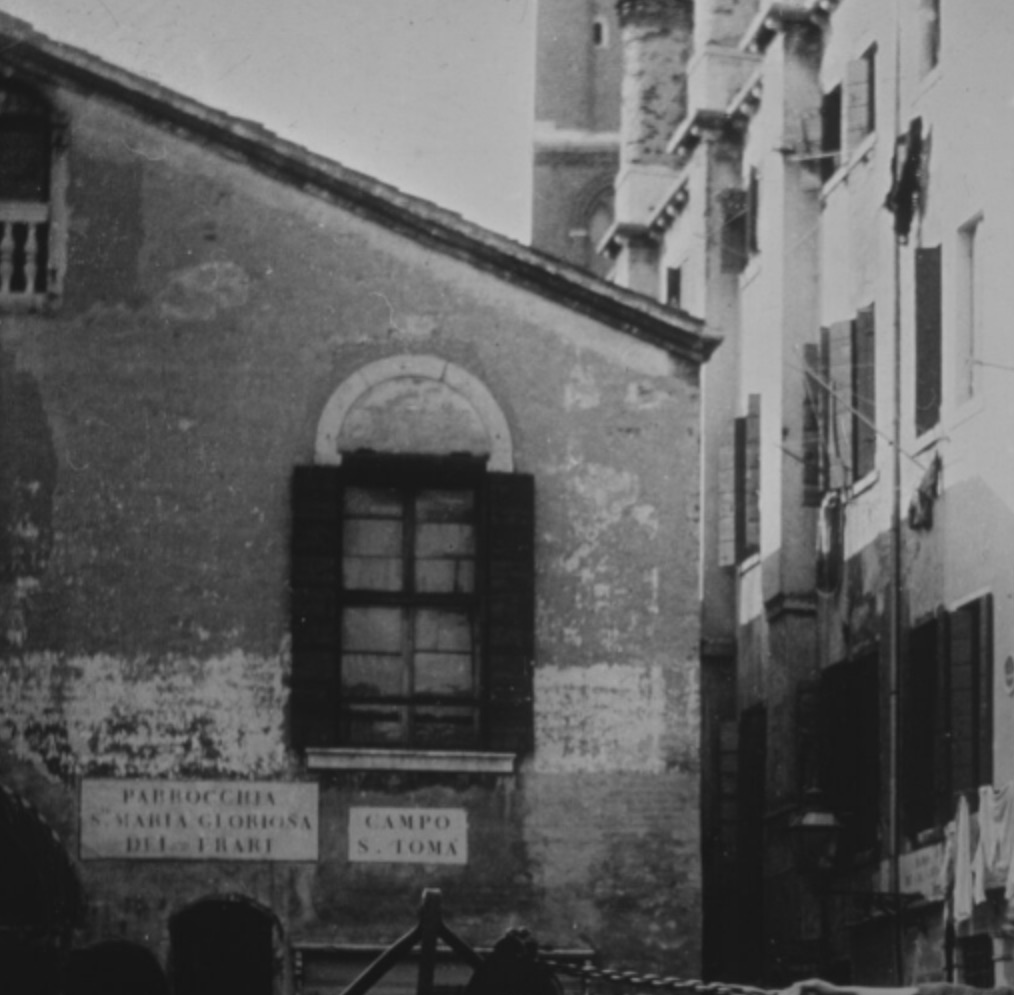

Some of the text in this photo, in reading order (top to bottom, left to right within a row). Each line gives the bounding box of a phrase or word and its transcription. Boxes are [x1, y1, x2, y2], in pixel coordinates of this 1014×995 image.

[123, 788, 276, 805] PARROCCHIA
[114, 813, 188, 829] MARIA
[197, 814, 314, 831] GLORIOSA
[365, 814, 452, 830] CAMPO
[199, 836, 273, 853] FRARI
[357, 838, 382, 854] S.
